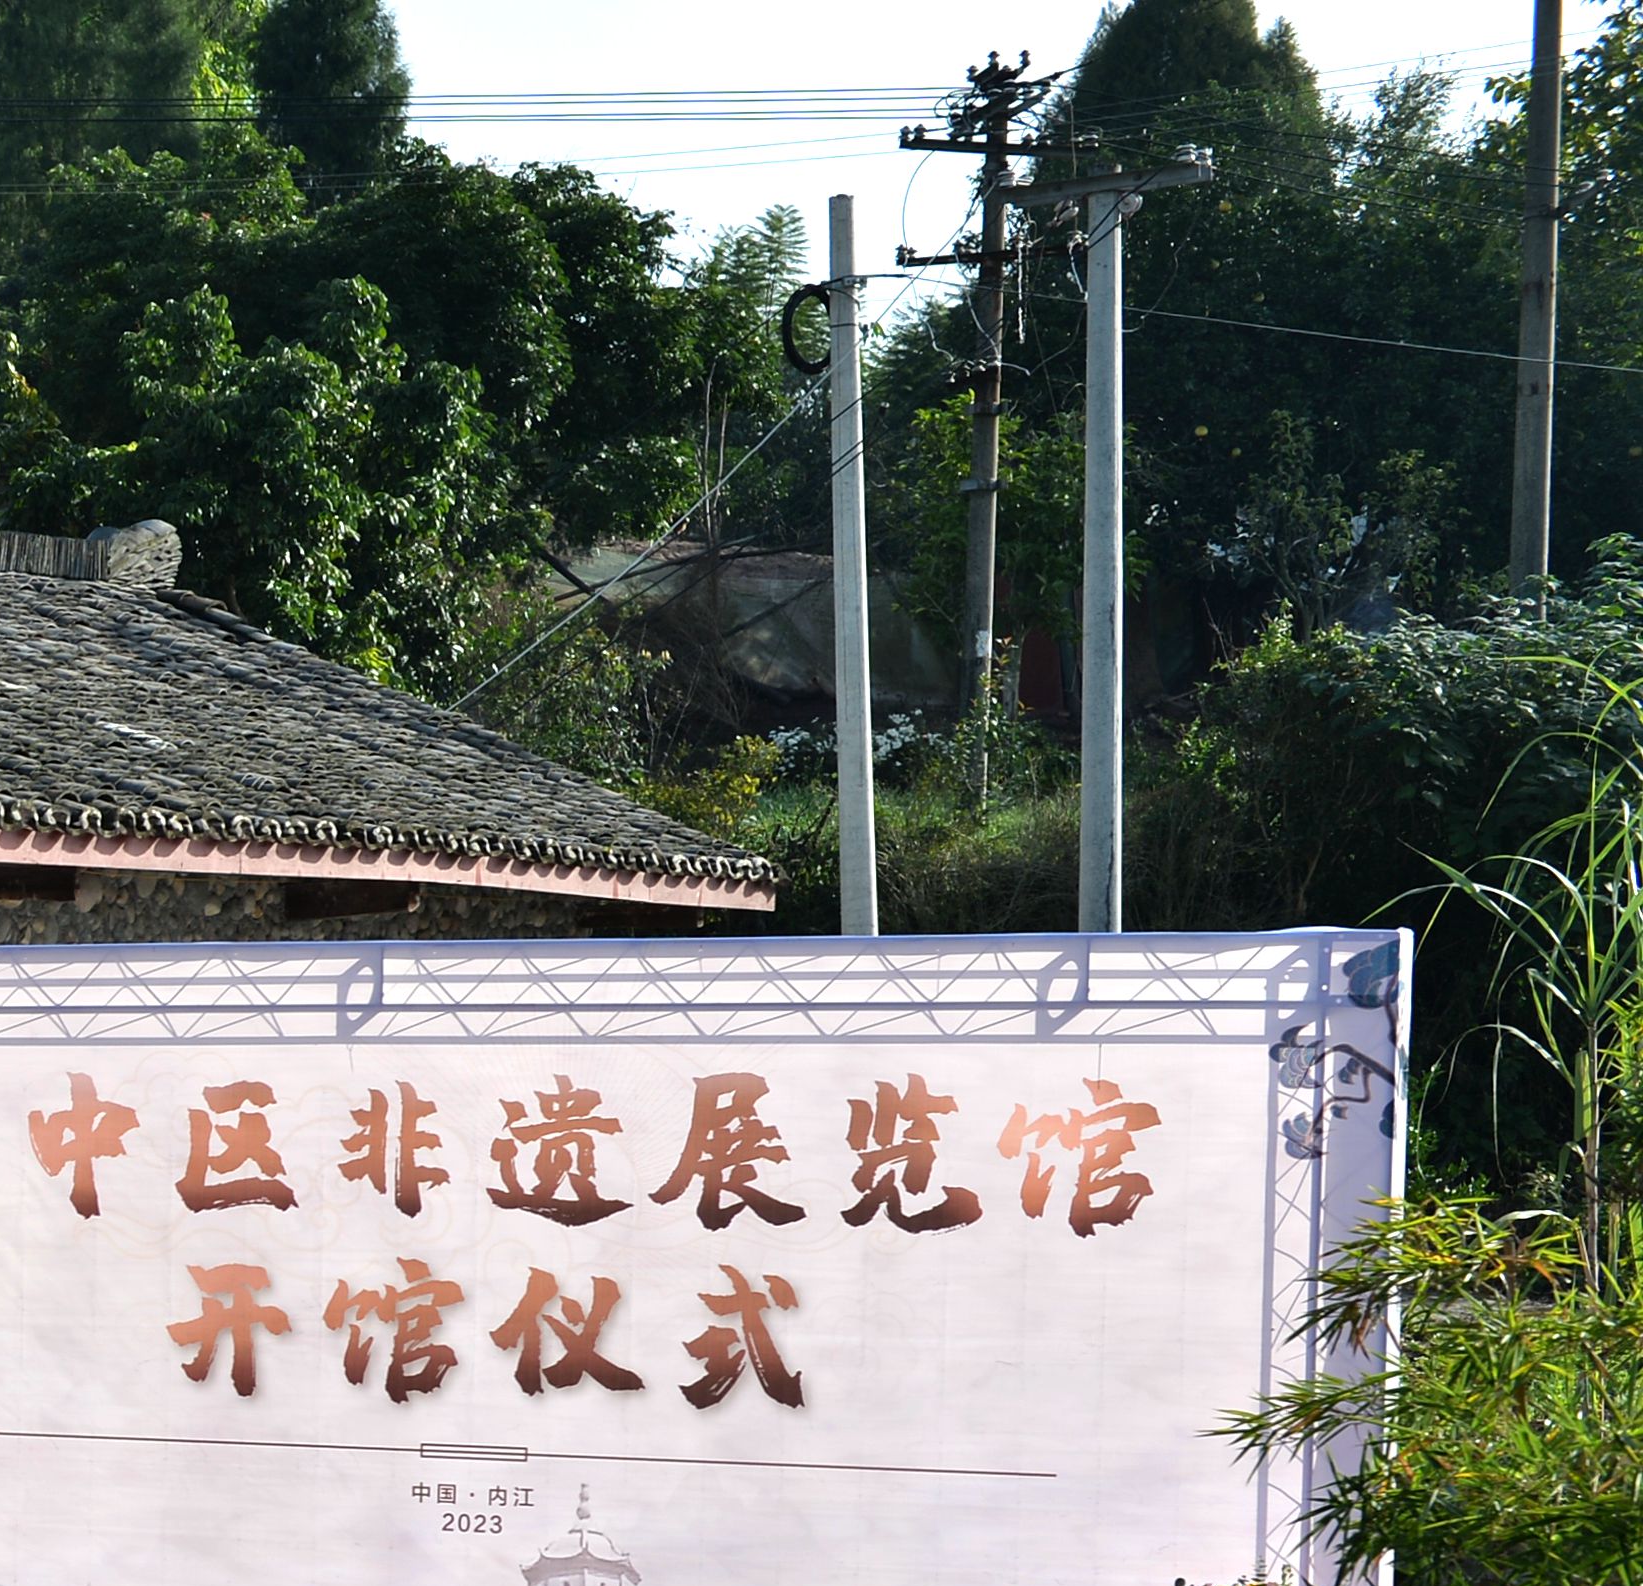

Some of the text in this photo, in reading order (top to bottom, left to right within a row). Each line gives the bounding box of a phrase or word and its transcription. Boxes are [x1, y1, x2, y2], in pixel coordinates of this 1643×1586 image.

[165, 1256, 807, 1411] 开馆仪式
[411, 1481, 535, 1508] 中国·内江
[441, 1513, 503, 1534] 2023
